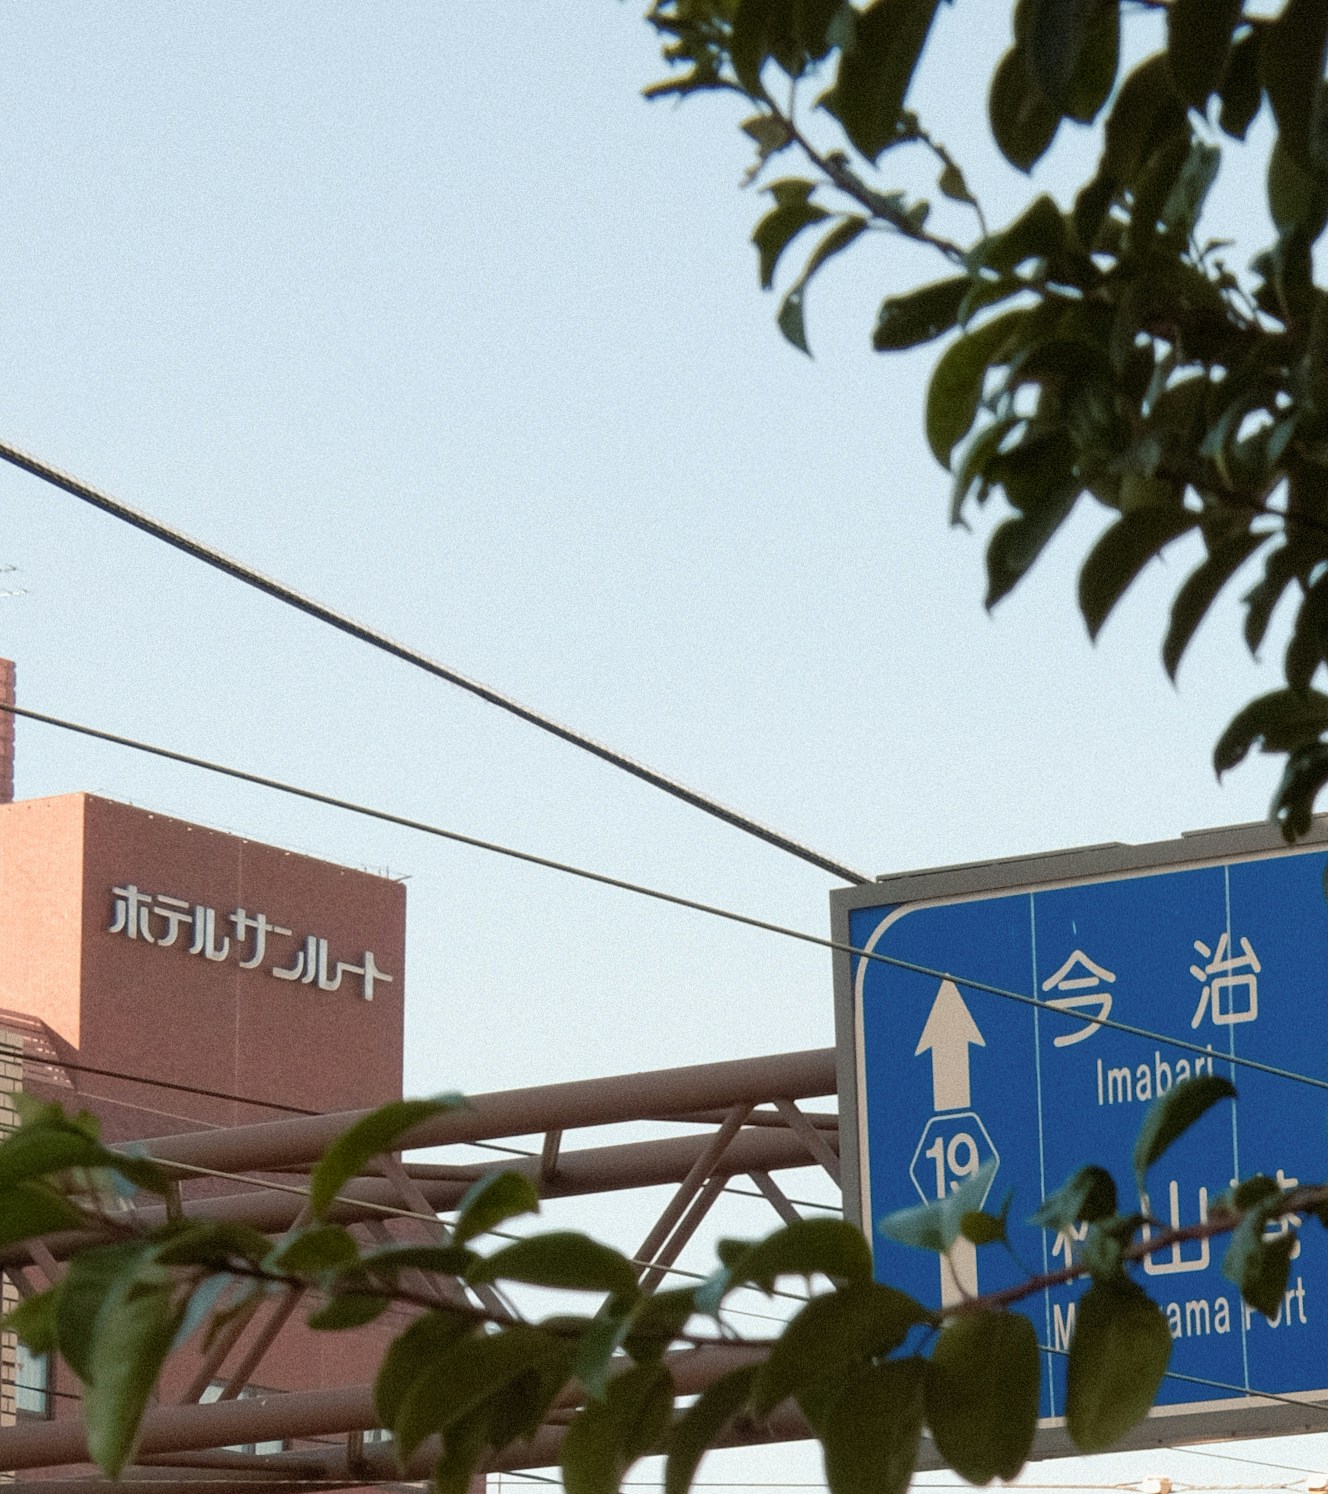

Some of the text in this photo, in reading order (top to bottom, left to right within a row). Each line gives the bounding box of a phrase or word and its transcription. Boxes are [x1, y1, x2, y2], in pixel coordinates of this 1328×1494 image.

[109, 884, 393, 1002] ホテルサンルート
[1041, 932, 1262, 1048] 今治
[925, 1131, 980, 1199] 19
